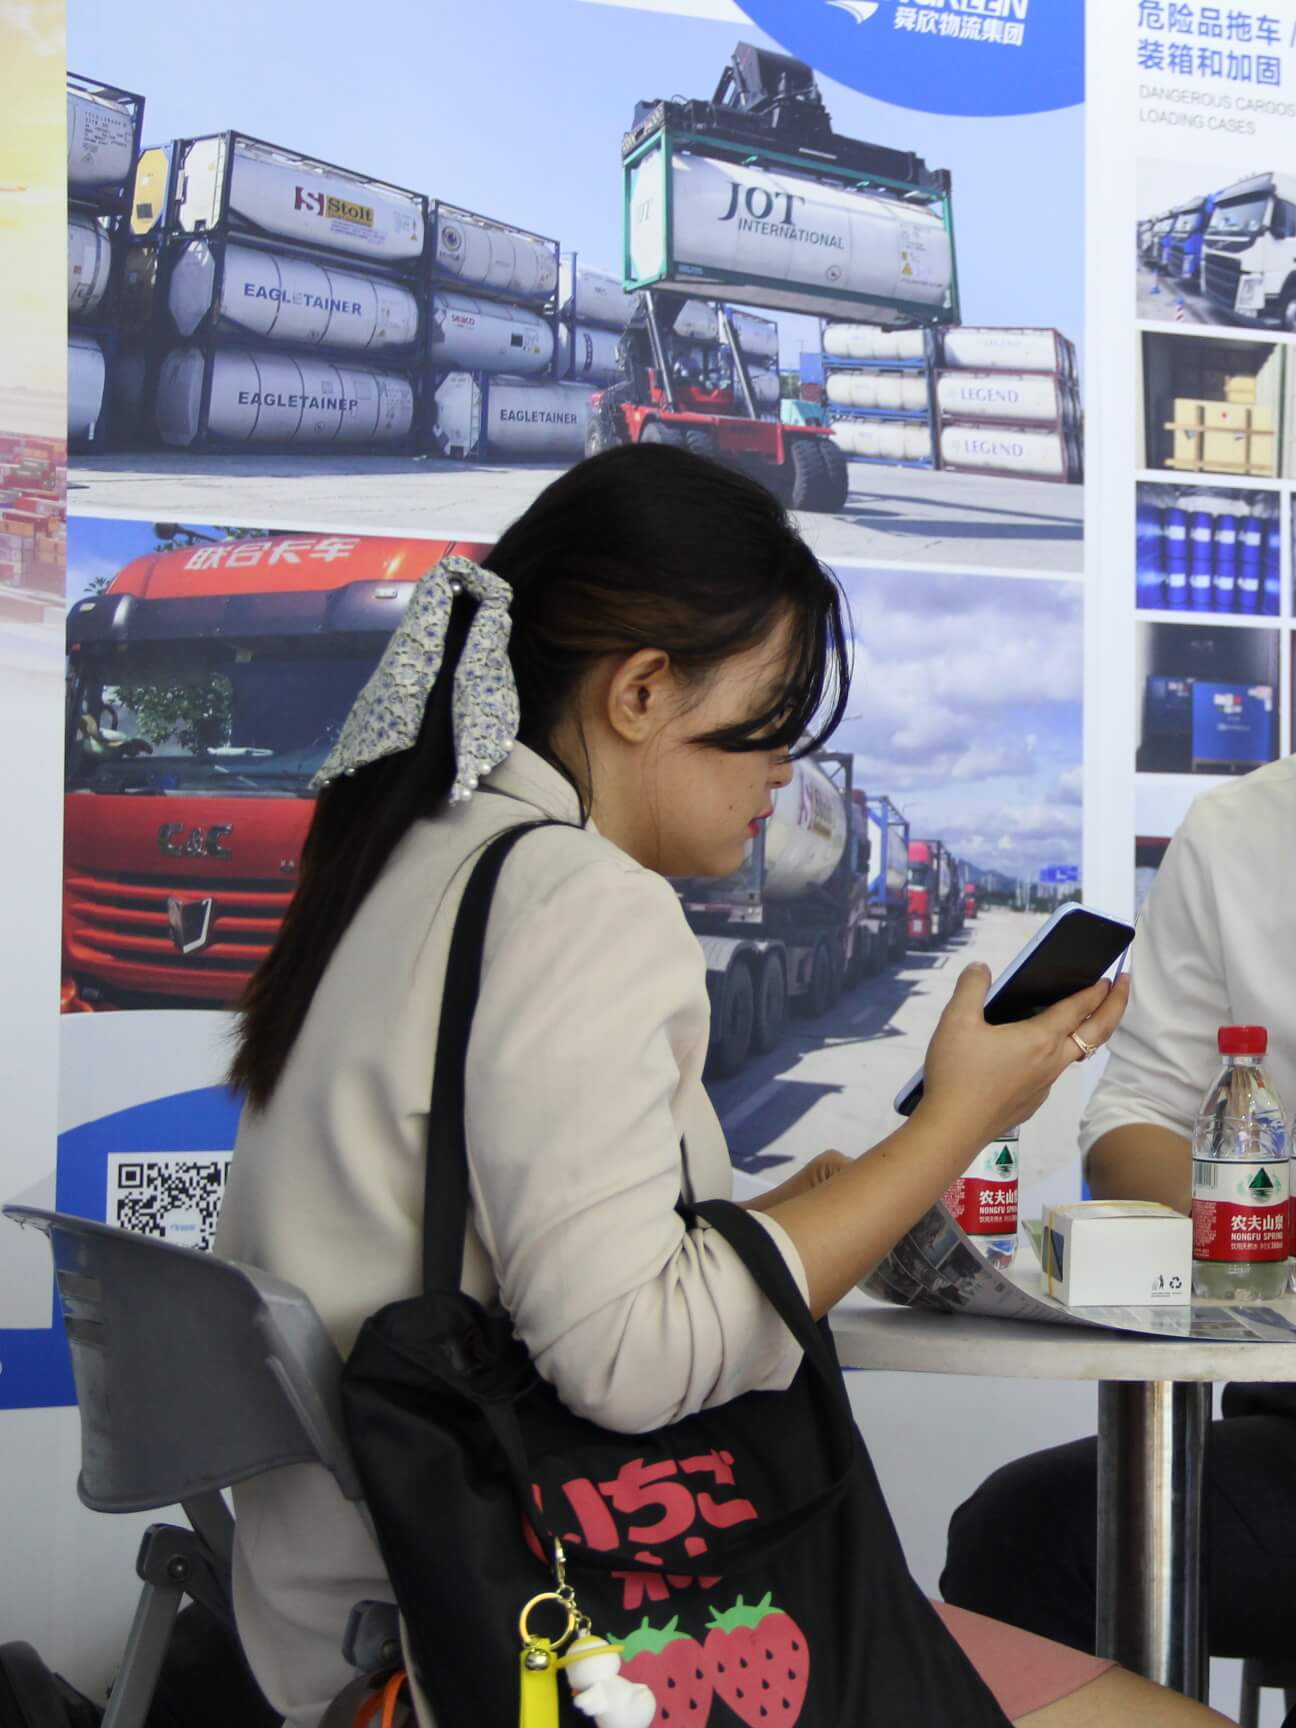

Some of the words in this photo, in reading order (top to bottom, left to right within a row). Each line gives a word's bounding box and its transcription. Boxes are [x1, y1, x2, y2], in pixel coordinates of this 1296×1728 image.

[894, 6, 1025, 47] 舜欣物流集团
[1137, 0, 1281, 46] 危险品拖车
[1137, 39, 1281, 86] 装箱和加固
[1138, 84, 1232, 110] DANGEROUS
[1138, 108, 1205, 128] LOADING
[1207, 115, 1256, 135] CASES
[327, 199, 373, 223] Stolt
[717, 181, 805, 226] JOT
[737, 217, 845, 250] INTERNATIONAL
[243, 283, 362, 315] EAGLETAINER
[960, 387, 1019, 403] LEGEND
[500, 409, 578, 424] EAGLETAINER
[964, 439, 1024, 457] LEGEND
[184, 537, 361, 570] 联合卡车
[1231, 1214, 1284, 1231] 农夫山泉
[1231, 1232, 1261, 1241] NONGFU
